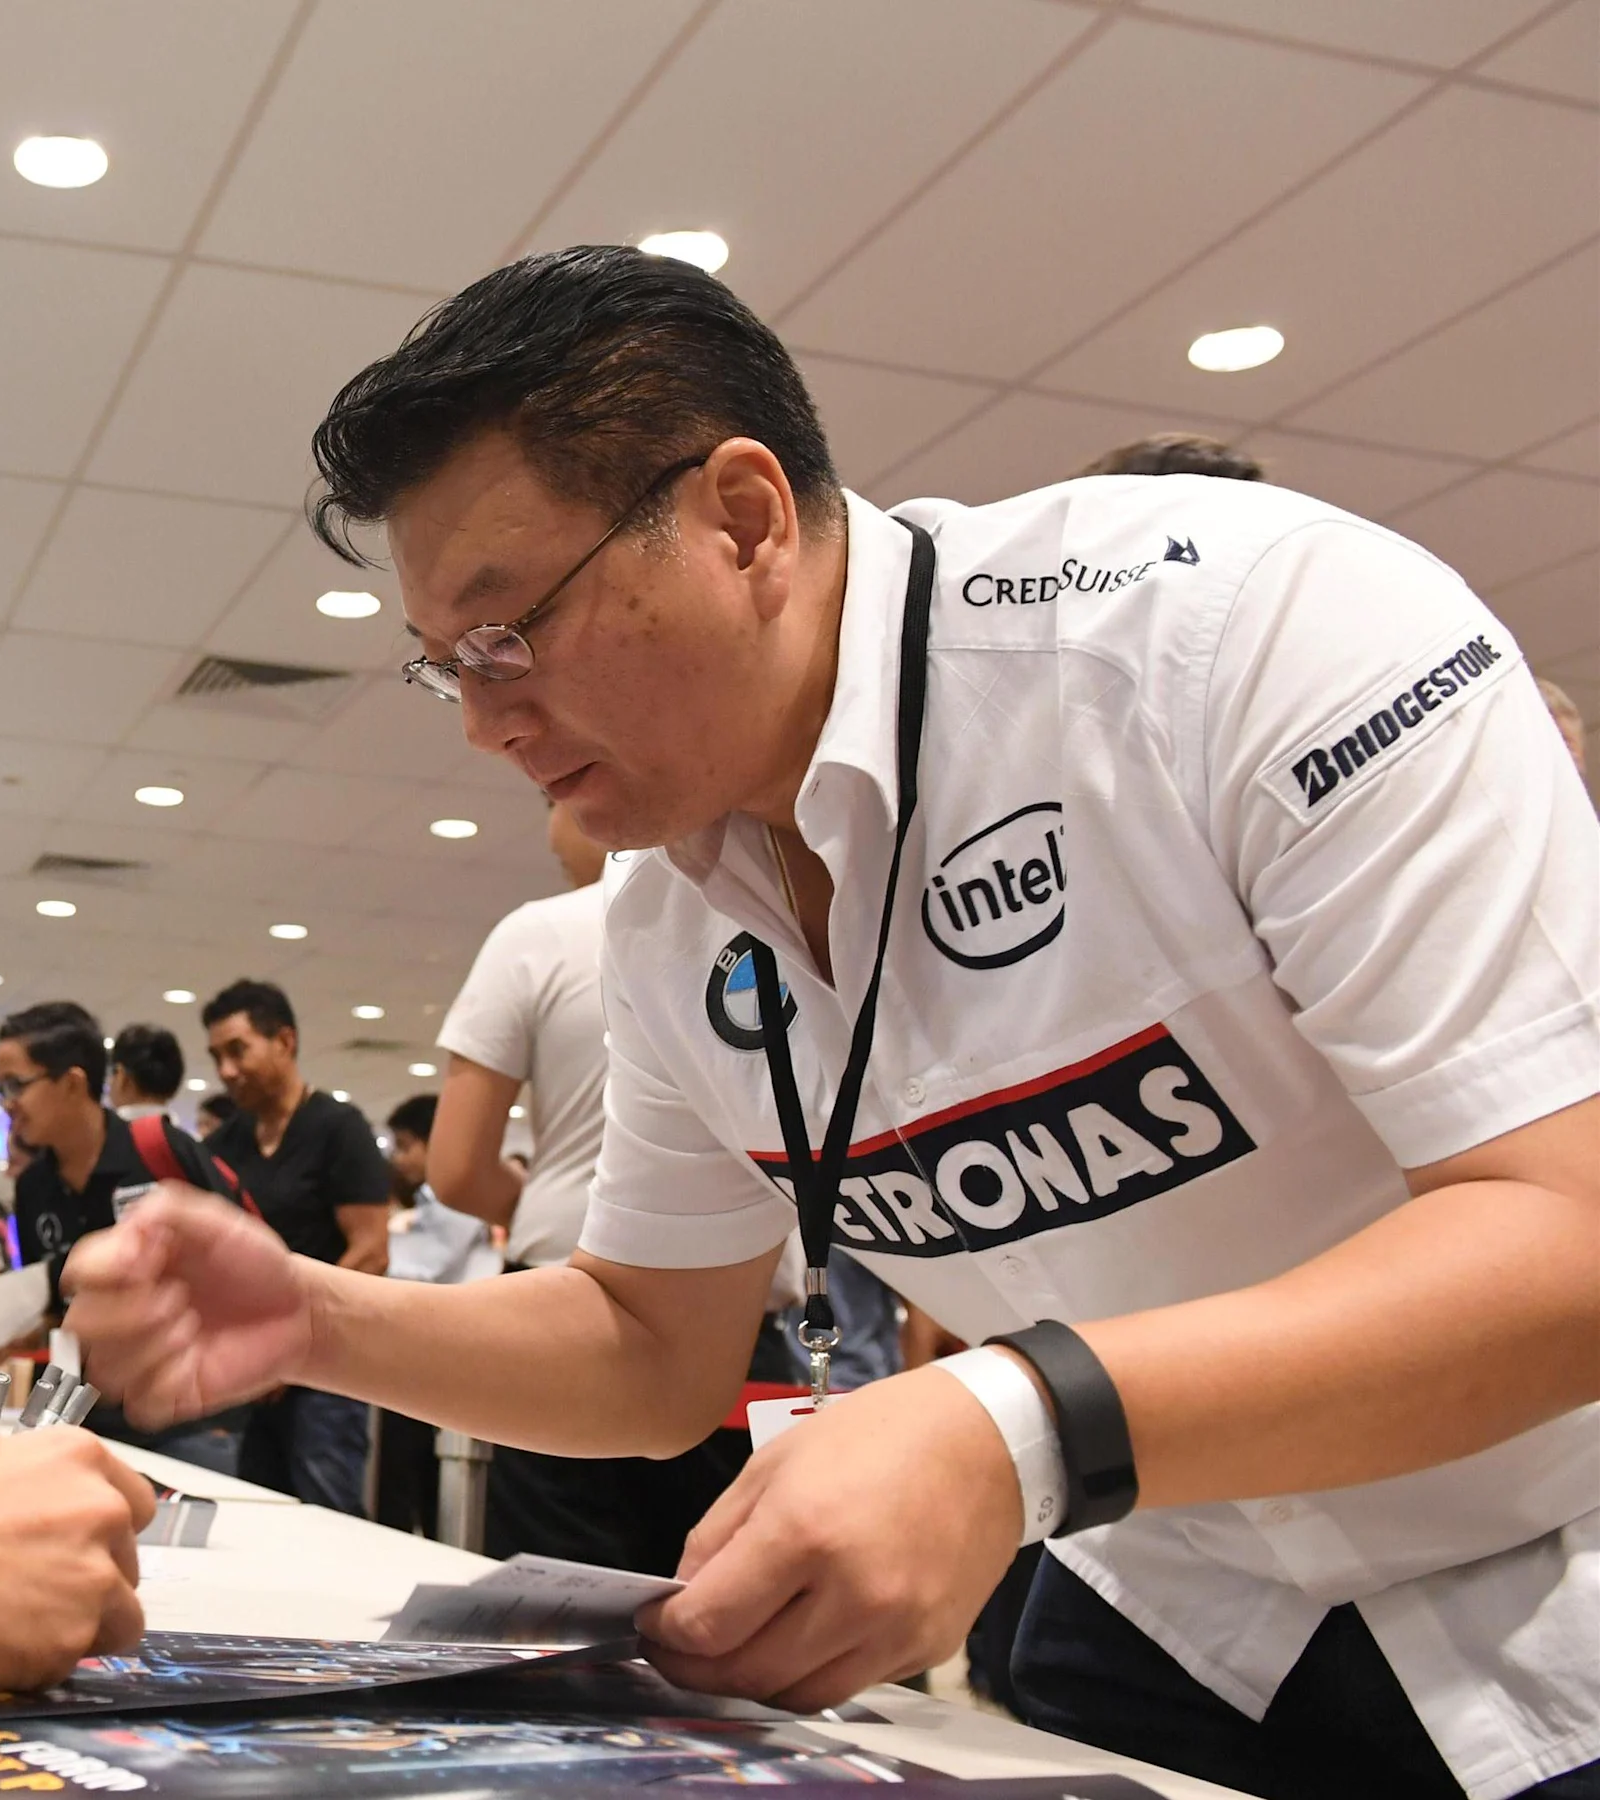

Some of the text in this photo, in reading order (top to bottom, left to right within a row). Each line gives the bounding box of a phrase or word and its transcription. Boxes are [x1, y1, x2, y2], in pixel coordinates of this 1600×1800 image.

[962, 573, 1060, 607] CRED
[1291, 634, 1502, 808] BRIDGESTONE
[932, 830, 1065, 932] intel
[773, 1064, 1223, 1245] ETRONAS
